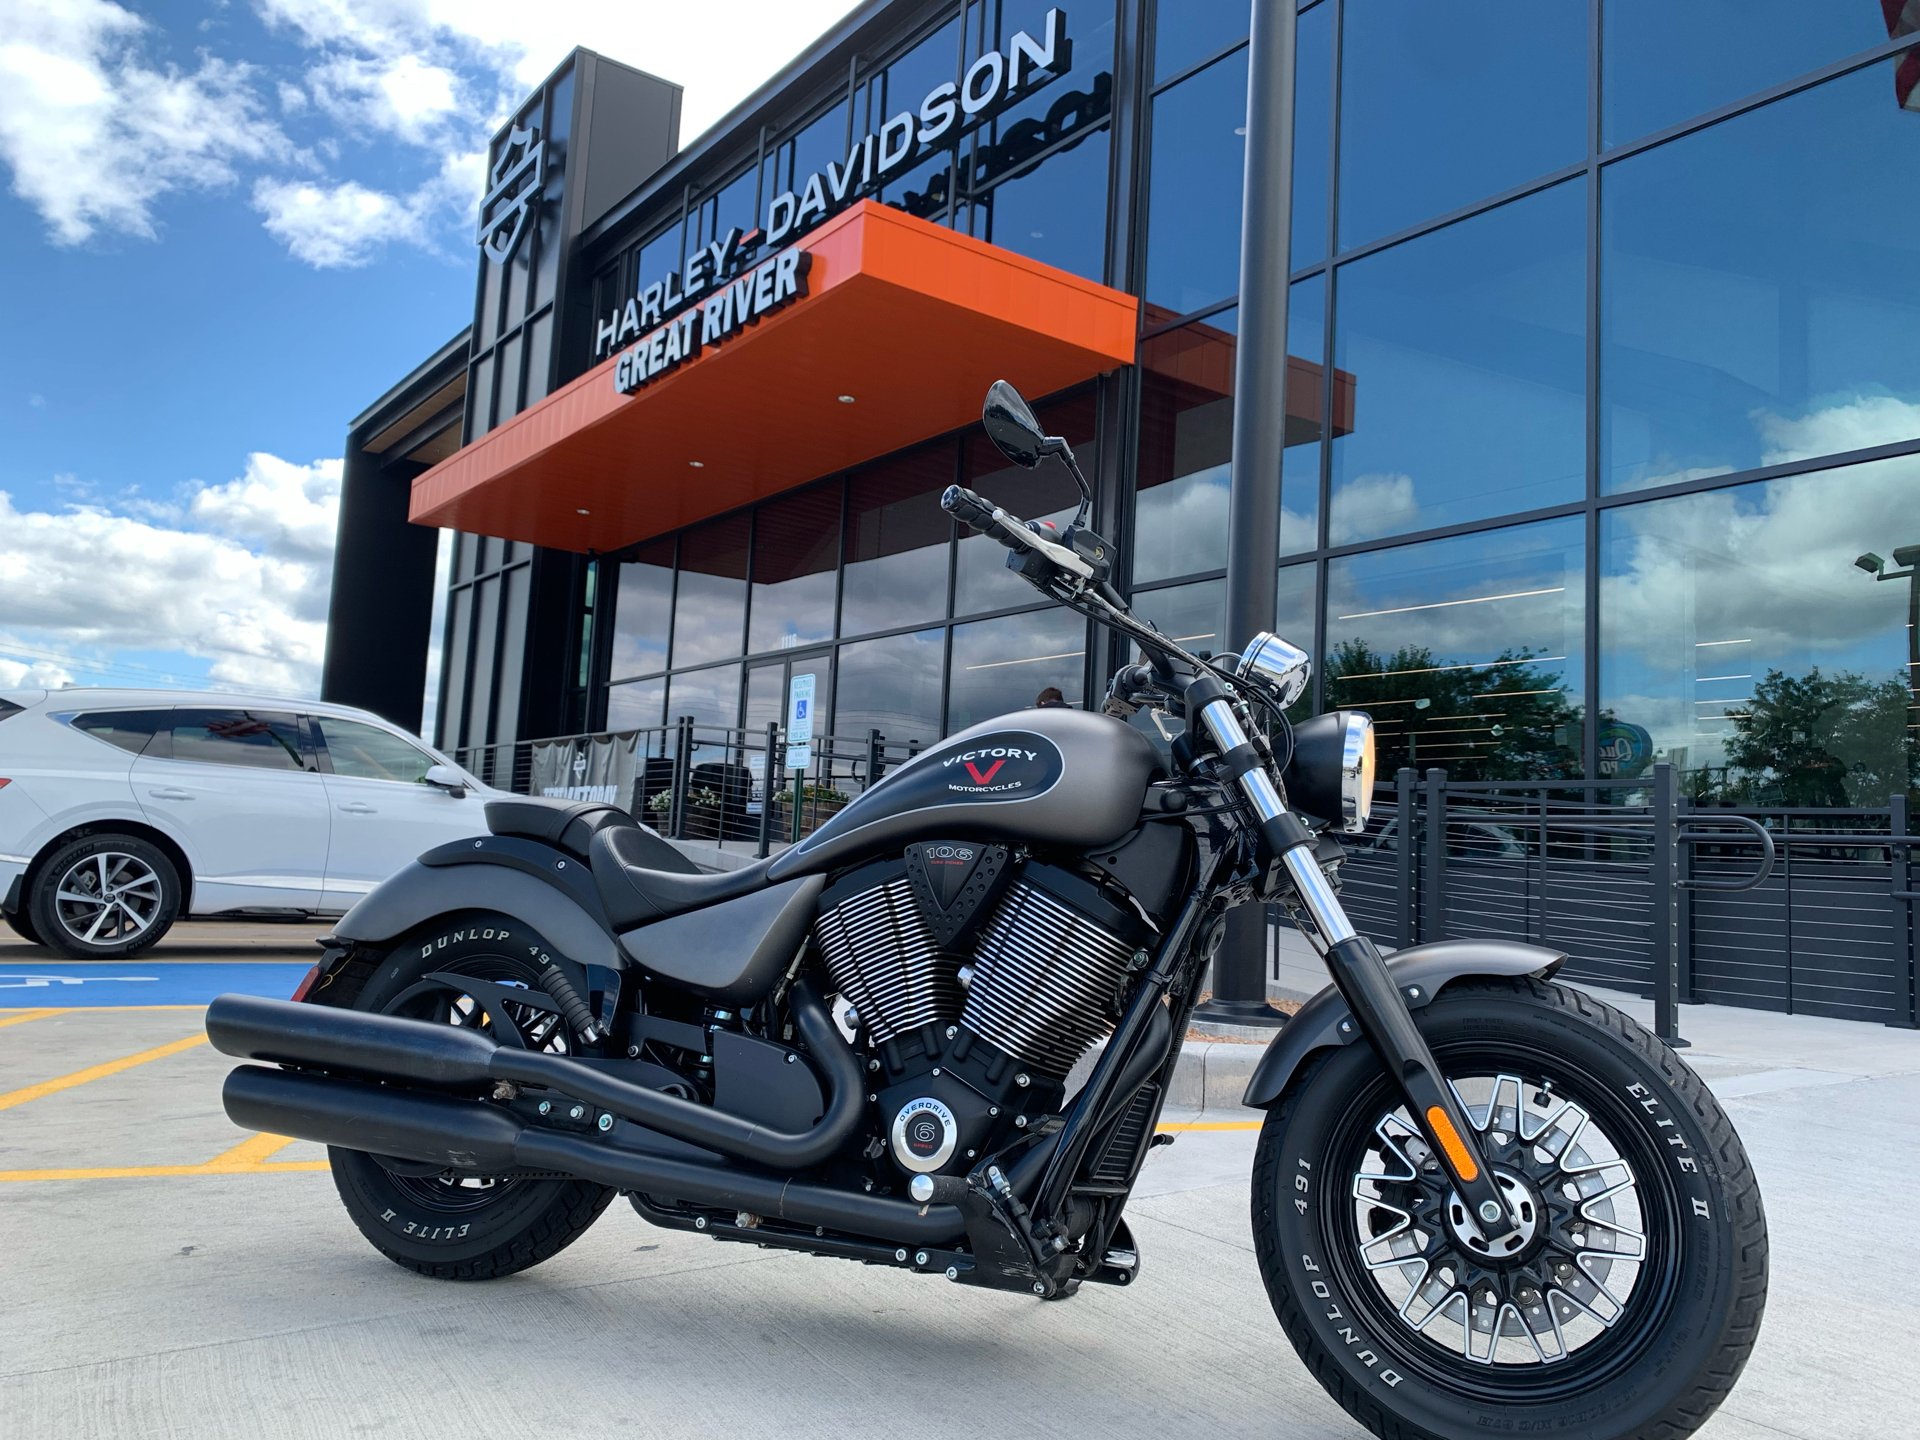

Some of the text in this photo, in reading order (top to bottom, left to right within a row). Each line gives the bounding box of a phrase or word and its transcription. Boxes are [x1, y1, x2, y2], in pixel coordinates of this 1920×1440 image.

[614, 247, 801, 395] GREAT RIVER
[794, 689, 811, 699] PARKING
[942, 748, 1037, 767] VICTORY
[948, 781, 1022, 792] MOTORCYCLES
[55, 844, 93, 874] MICHELIN
[926, 846, 974, 860] 106
[127, 921, 164, 951] MICHELIN
[422, 928, 510, 958] DUNLOP
[900, 1102, 951, 1127] OVERDRIVE
[914, 1122, 935, 1142] 6
[1626, 1082, 1698, 1174] ELITE
[1692, 1197, 1710, 1220] II
[380, 1208, 470, 1240] ELITE II
[1294, 1158, 1404, 1388] DUNLOP 491
